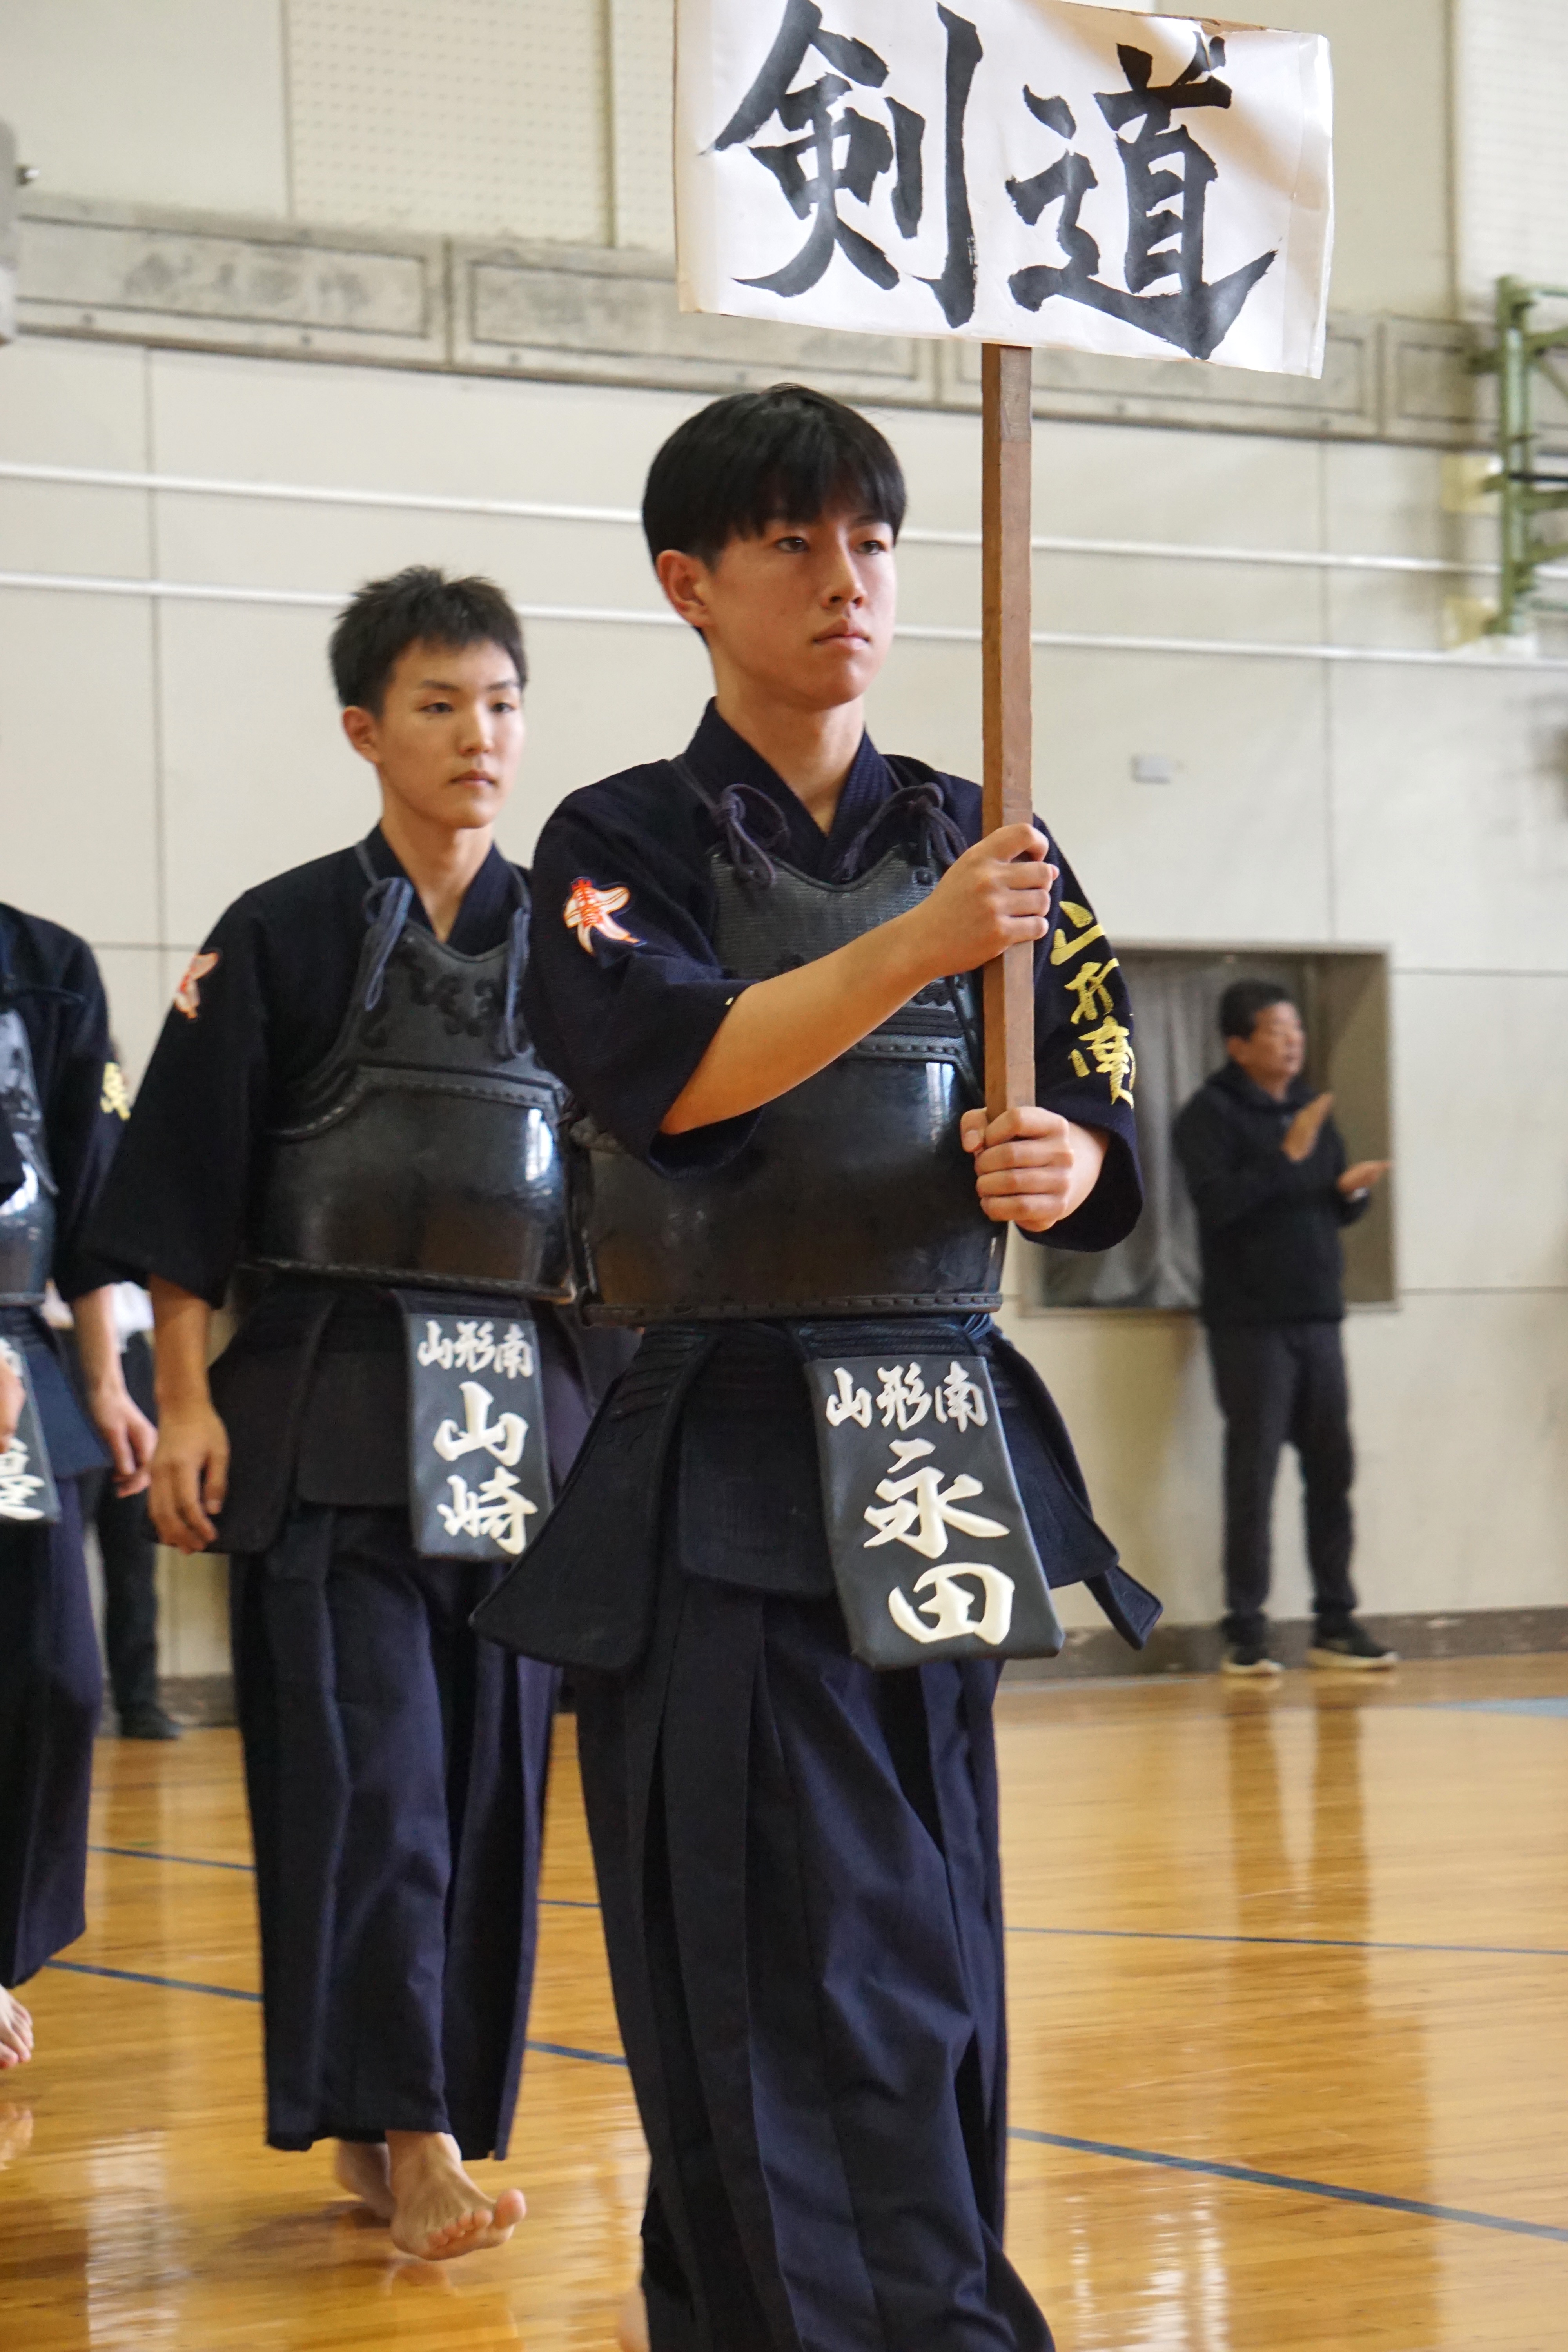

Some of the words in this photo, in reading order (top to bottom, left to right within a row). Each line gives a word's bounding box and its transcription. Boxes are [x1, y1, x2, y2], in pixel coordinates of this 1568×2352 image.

[699, 0, 1279, 360] 剣道
[417, 1320, 533, 1378] 山形南
[826, 1361, 988, 1432] 山形南
[433, 1381, 538, 1555] 山崎
[864, 1437, 1015, 1645] 永田
